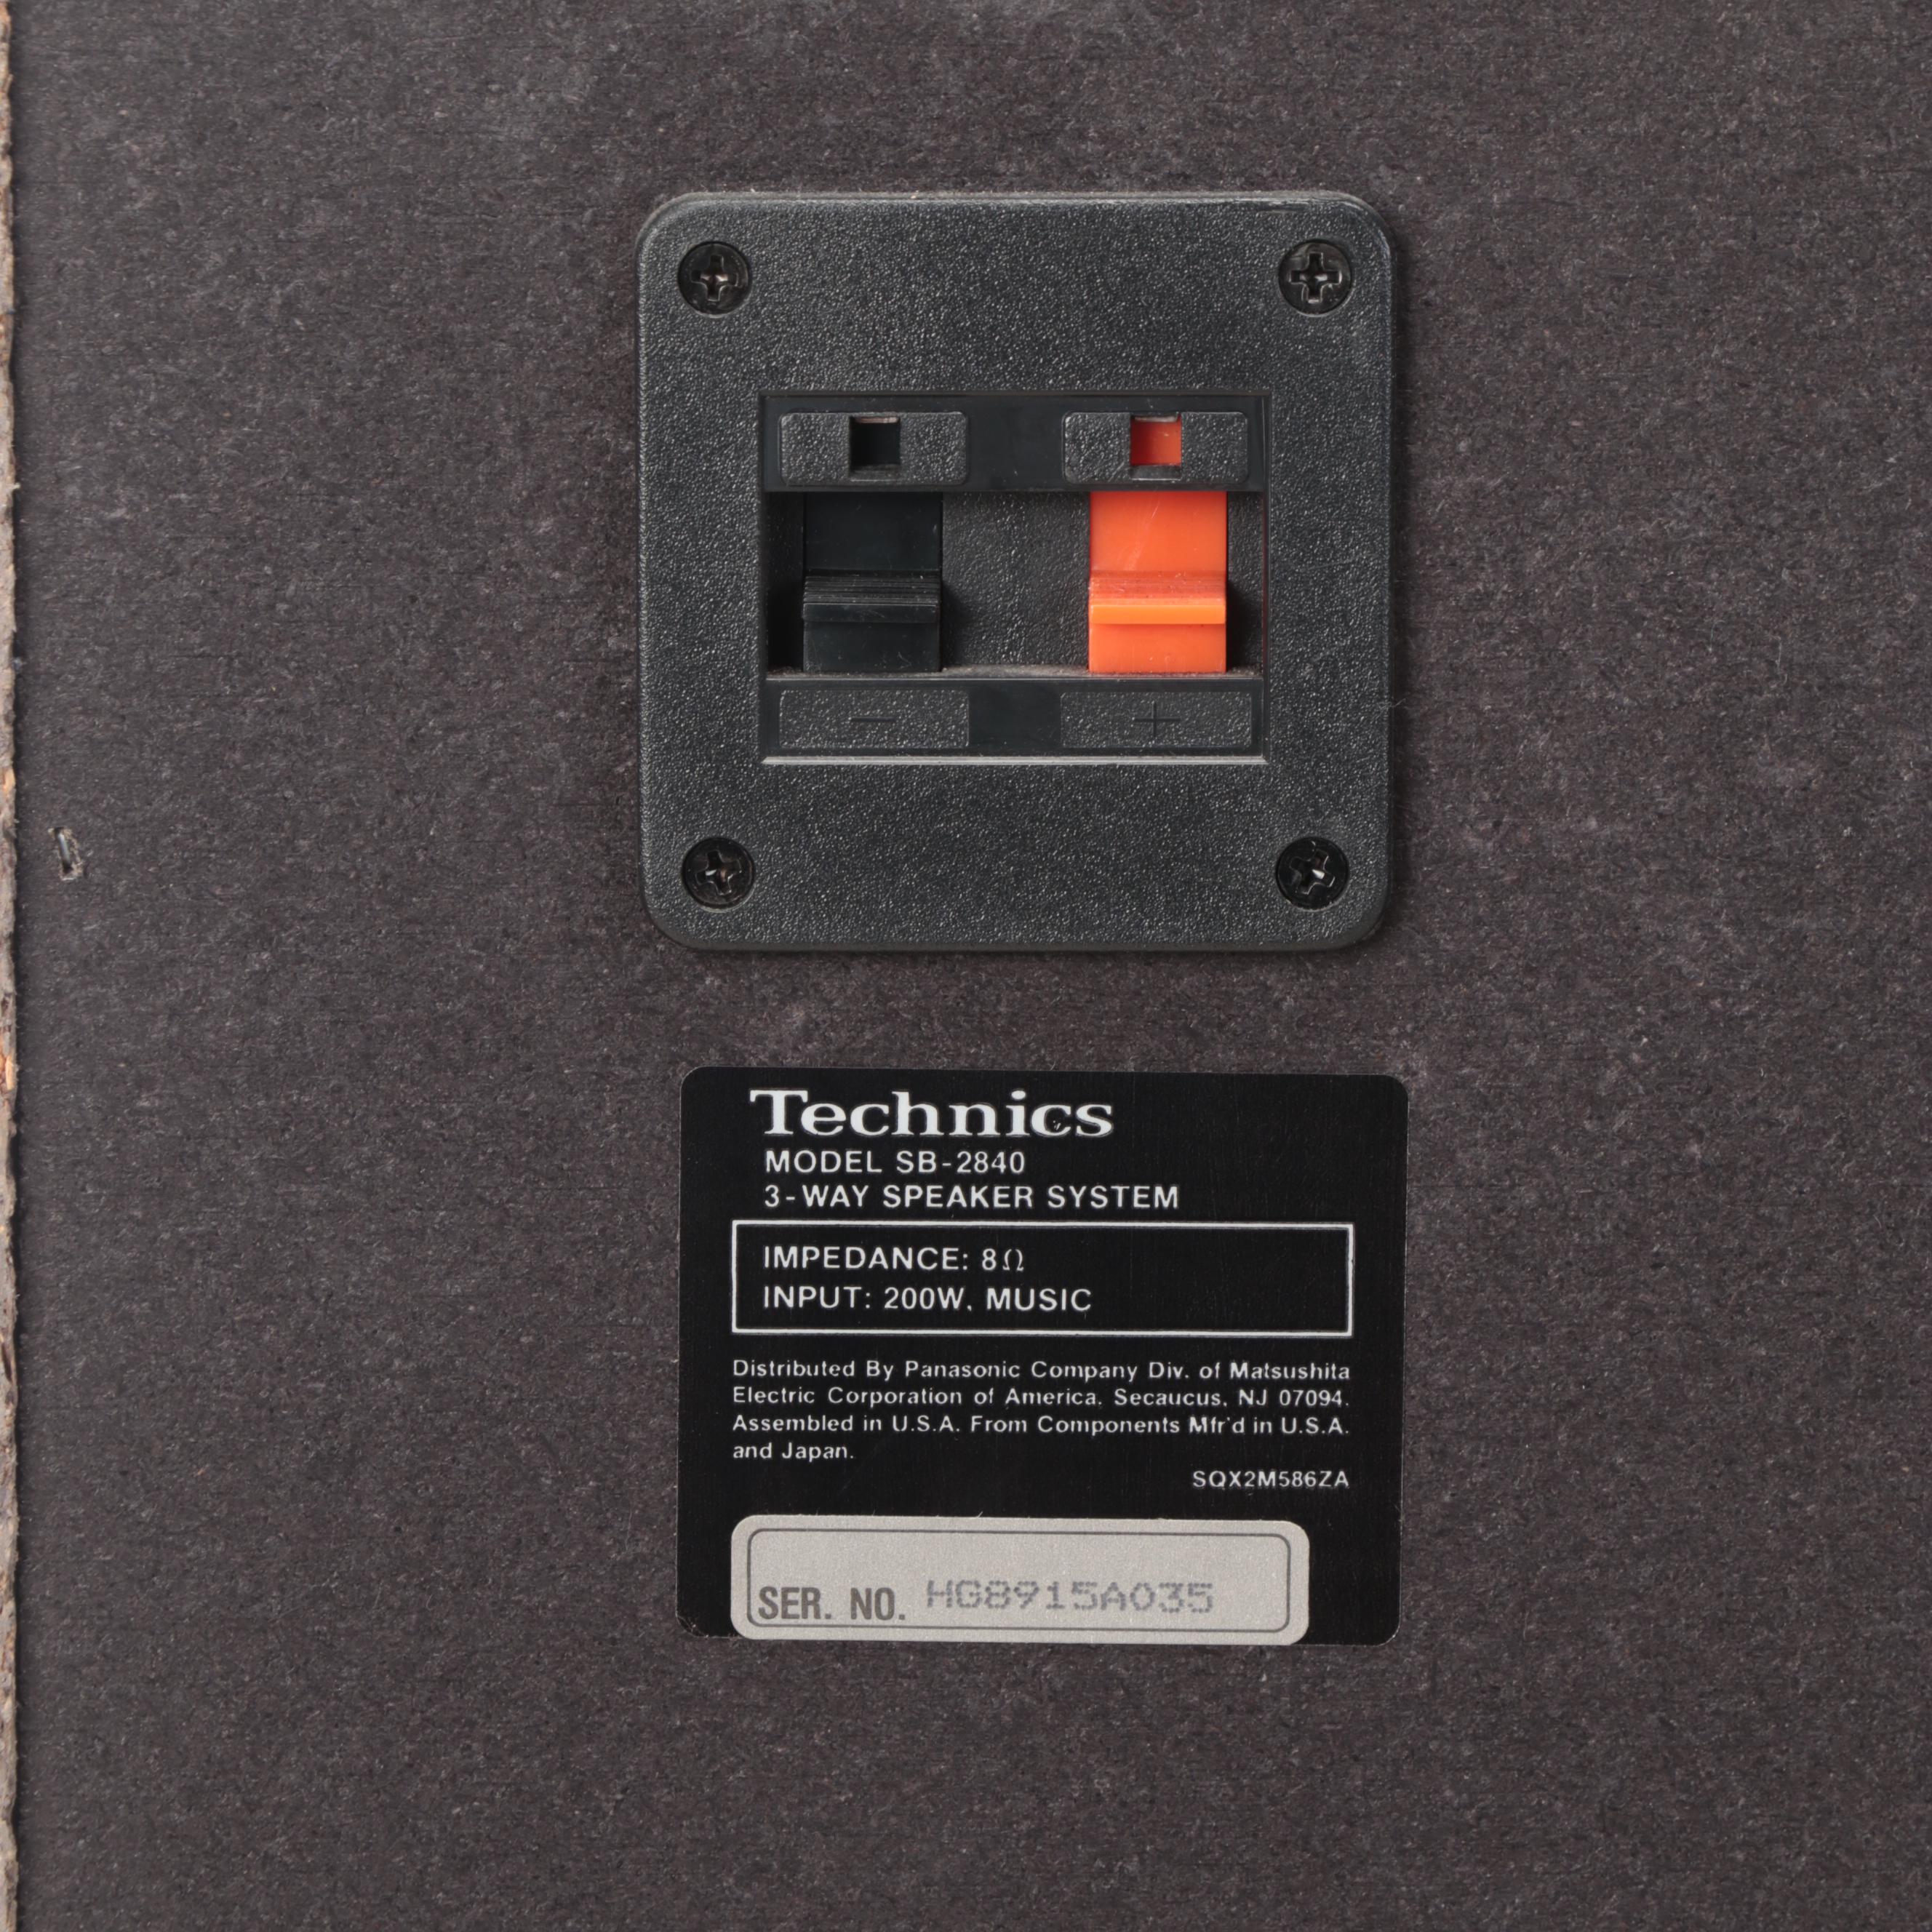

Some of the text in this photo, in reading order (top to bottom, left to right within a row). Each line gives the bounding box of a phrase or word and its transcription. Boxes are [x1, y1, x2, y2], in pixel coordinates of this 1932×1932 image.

[750, 1090, 1112, 1137] Technics
[766, 1150, 1024, 1174] MODEL SB-2840
[765, 1185, 1178, 1208] 3-WAY SPEAKER SYSTEM
[765, 1246, 967, 1270] IMPEDANCE:
[765, 1286, 870, 1308] INPUT:
[987, 1288, 1090, 1312] MUSIC
[734, 1360, 1349, 1382] Distributed By Panasonic Company Div. of Matsushita
[734, 1386, 814, 1403] Electric
[829, 1387, 961, 1408] Corporation
[975, 1388, 993, 1405] of
[1240, 1389, 1266, 1405] NJ
[1280, 1389, 1349, 1406] 07094.
[733, 1415, 1350, 1436] Assembled in U.S.A. From Components Mfr'd in U.S.A.
[733, 1442, 853, 1462] and Japan.
[1194, 1471, 1349, 1487] SQX2M586ZA
[759, 1579, 1214, 1620] SER. NO. HG8915A035
